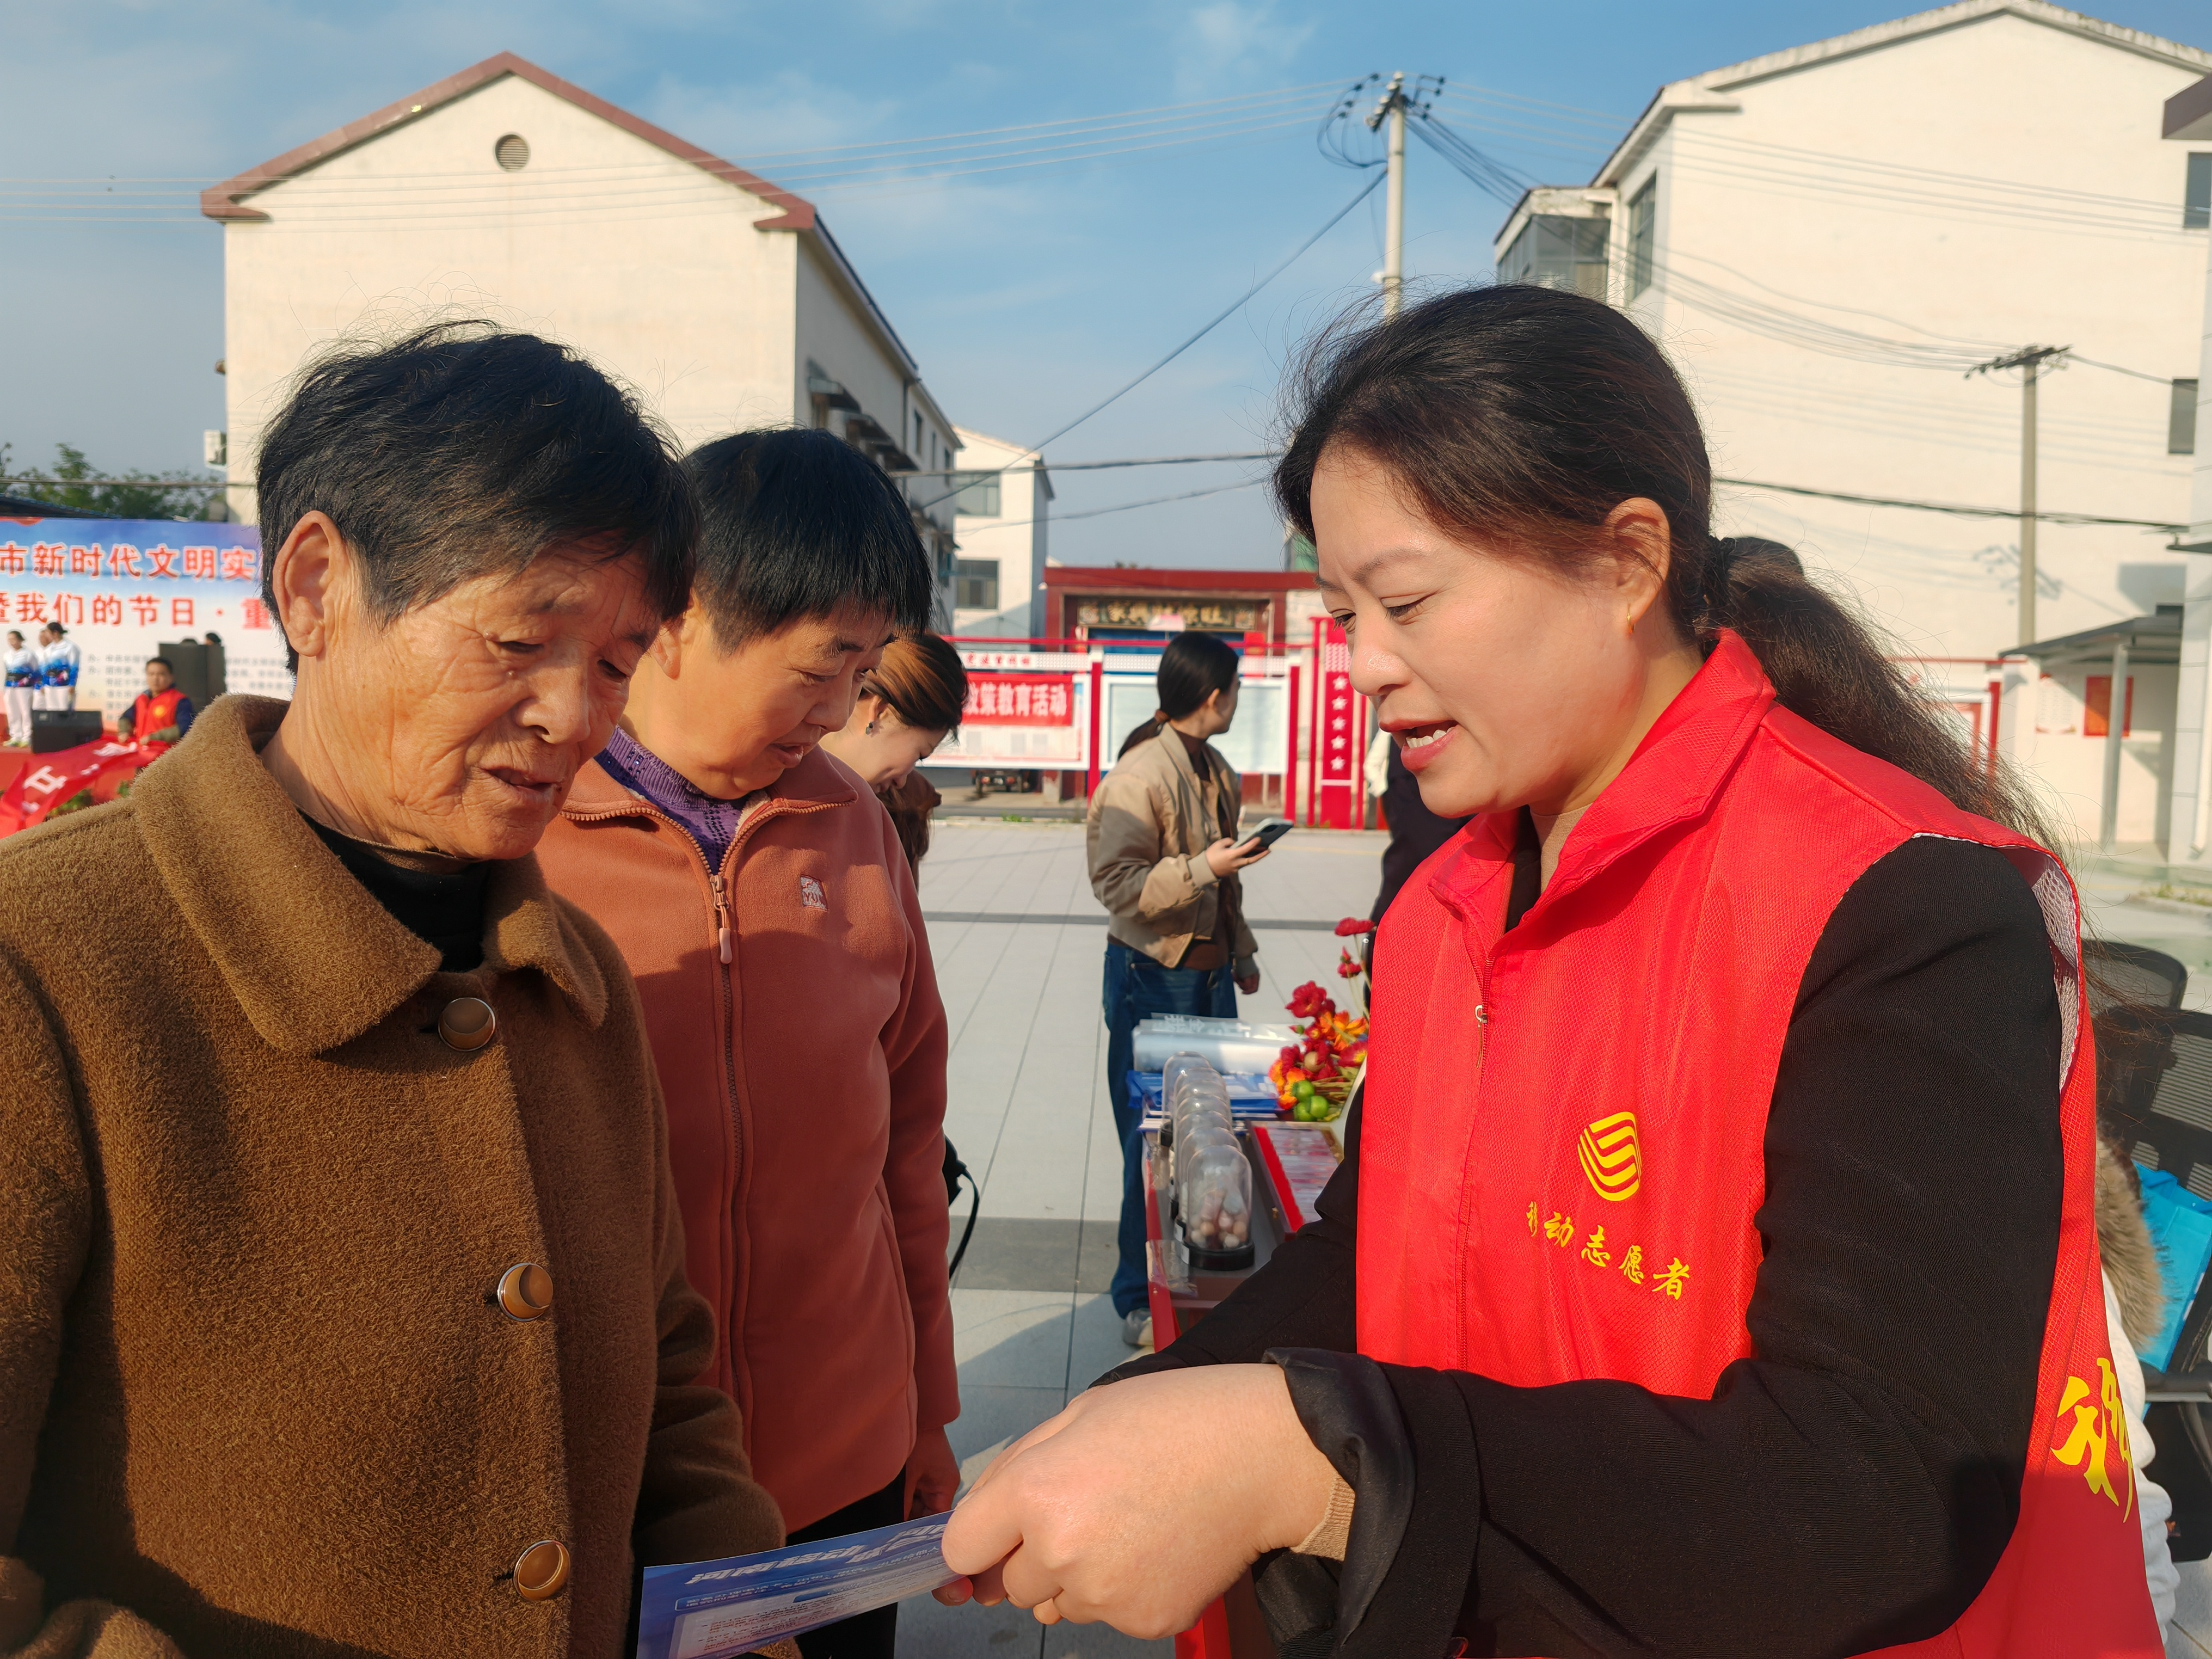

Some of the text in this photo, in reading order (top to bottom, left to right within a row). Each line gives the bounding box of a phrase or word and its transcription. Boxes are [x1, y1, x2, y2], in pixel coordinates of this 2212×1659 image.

[0, 544, 255, 581] 市新时代文明实
[1526, 1201, 1690, 1300] 移动志愿者
